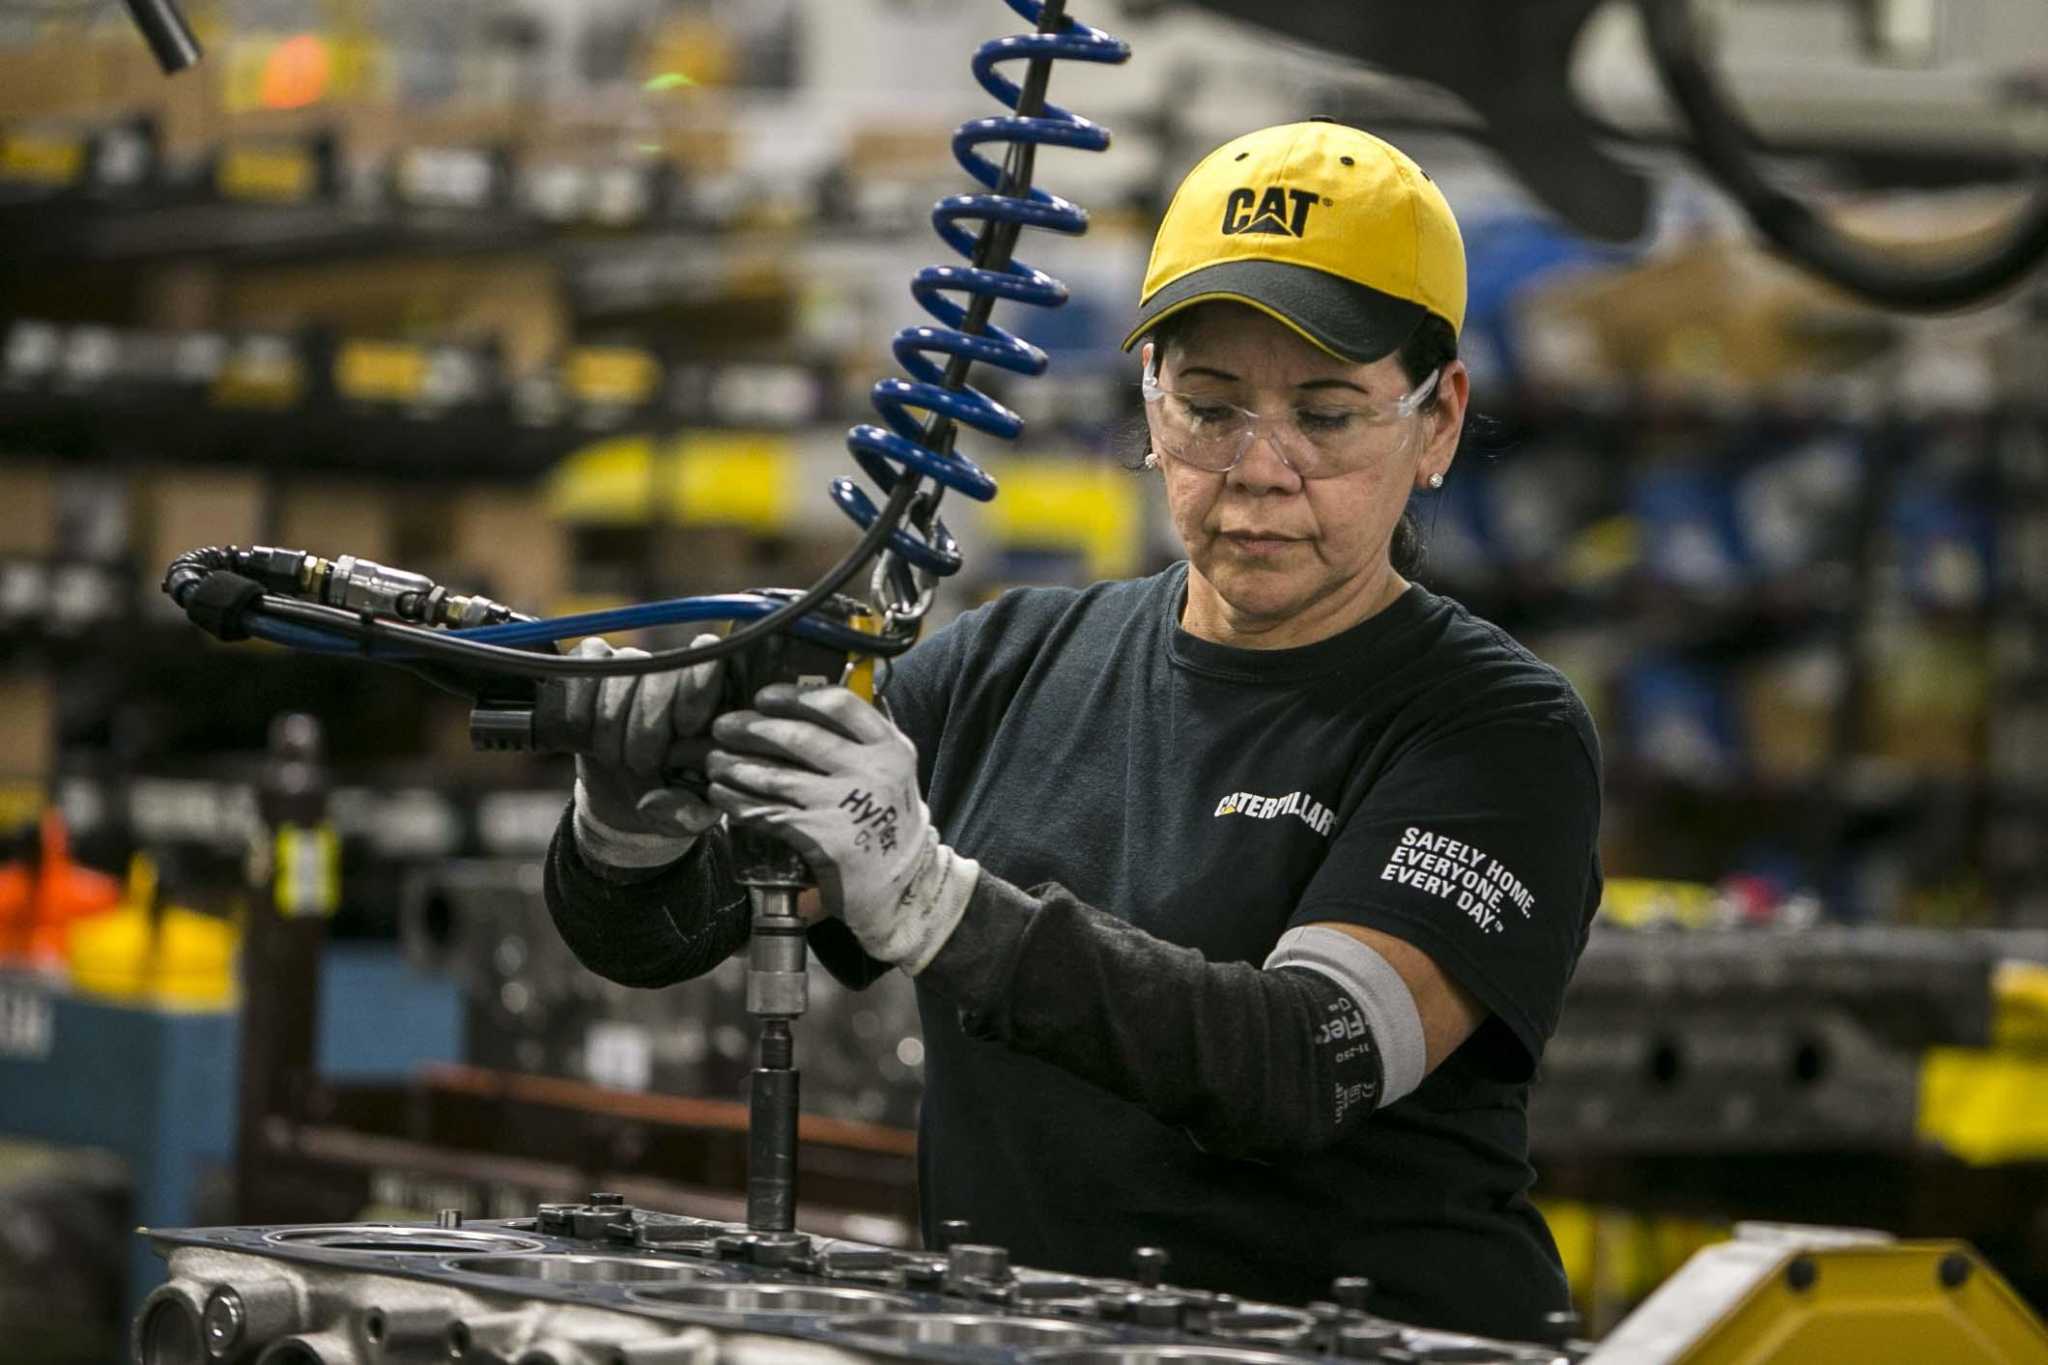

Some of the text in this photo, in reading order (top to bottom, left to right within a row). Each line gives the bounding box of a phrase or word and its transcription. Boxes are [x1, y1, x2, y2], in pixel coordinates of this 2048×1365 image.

[1222, 186, 1320, 238] CAT
[1214, 791, 1335, 837] CATERPILLAR
[1380, 863, 1456, 899] EVERY
[1391, 846, 1504, 913] EVERYONE.
[1401, 827, 1535, 919] SAFELY HOME.
